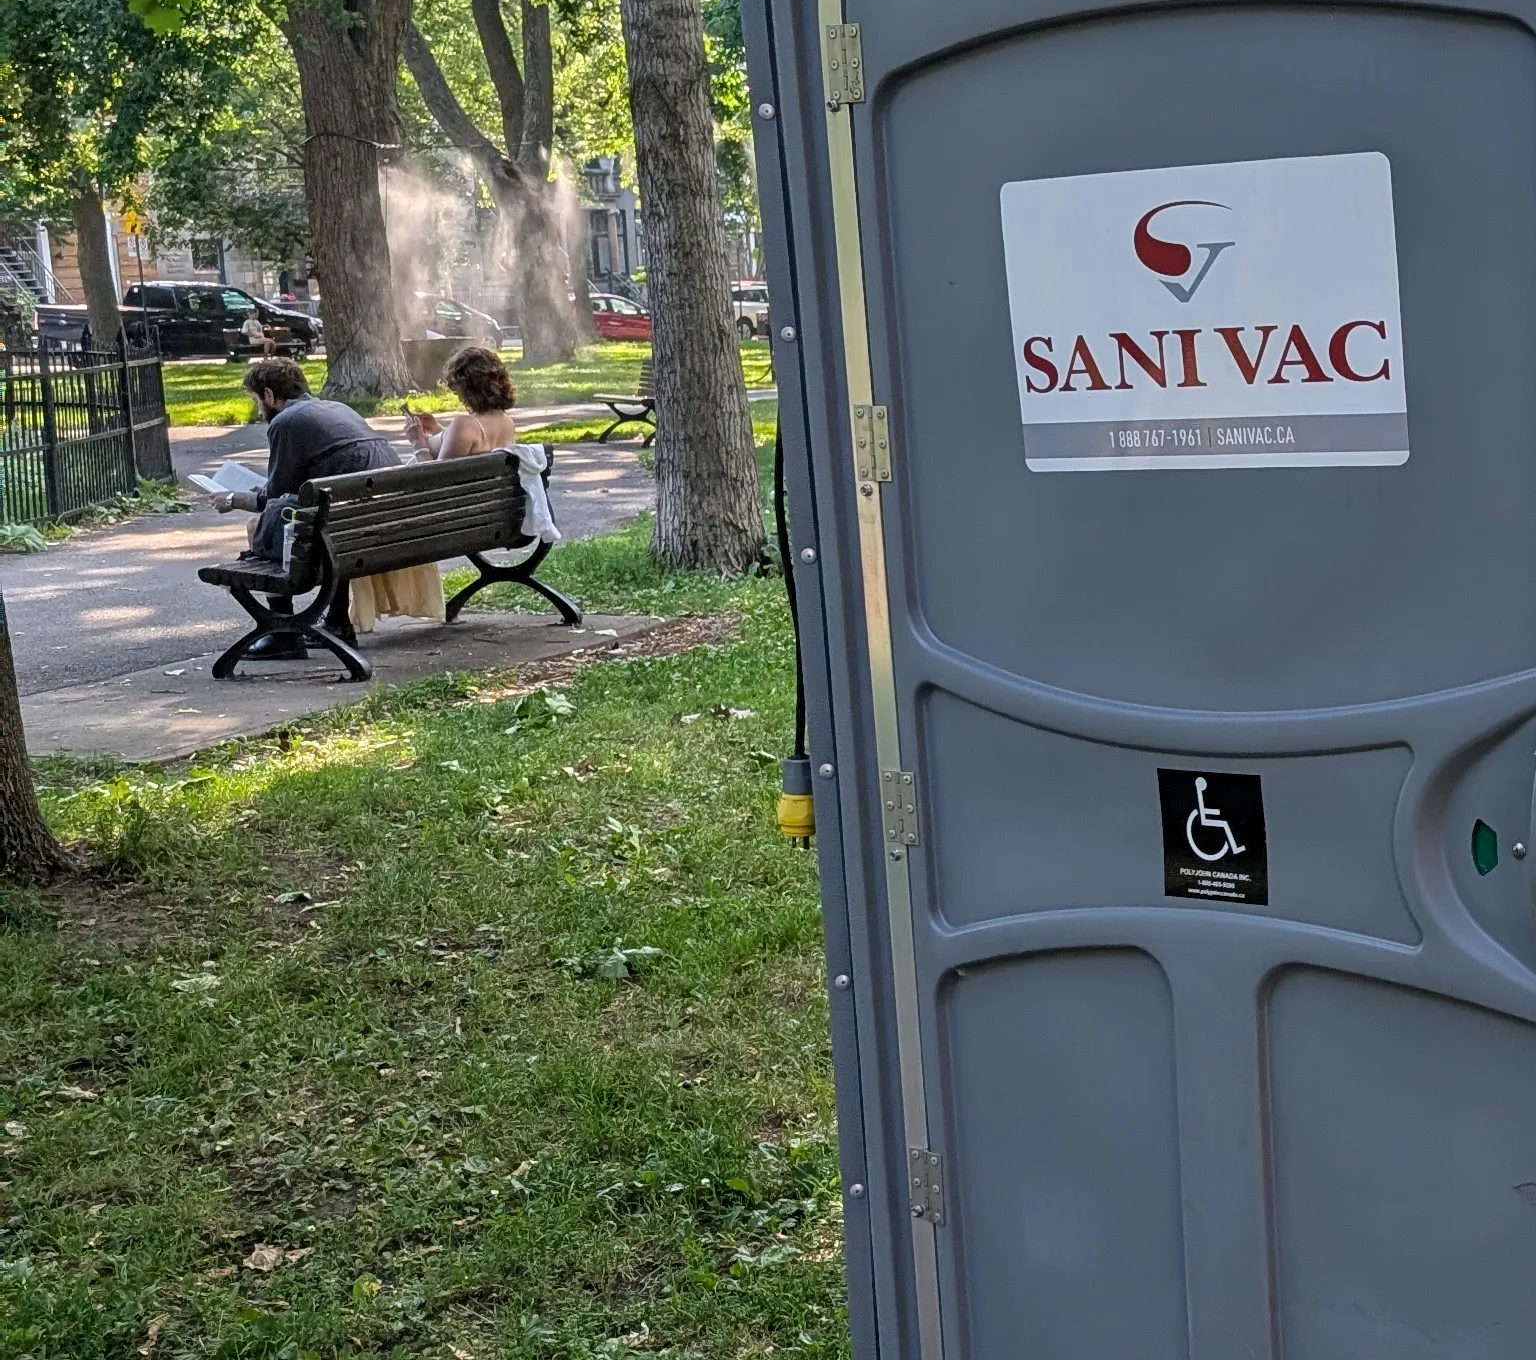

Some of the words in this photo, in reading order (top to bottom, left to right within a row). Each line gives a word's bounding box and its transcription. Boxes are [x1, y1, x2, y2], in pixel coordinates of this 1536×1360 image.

[1108, 431, 1116, 449] 1
[1118, 430, 1141, 449] 888
[1142, 428, 1203, 448] 767-1961
[1216, 426, 1296, 447] SANIVAC.CA
